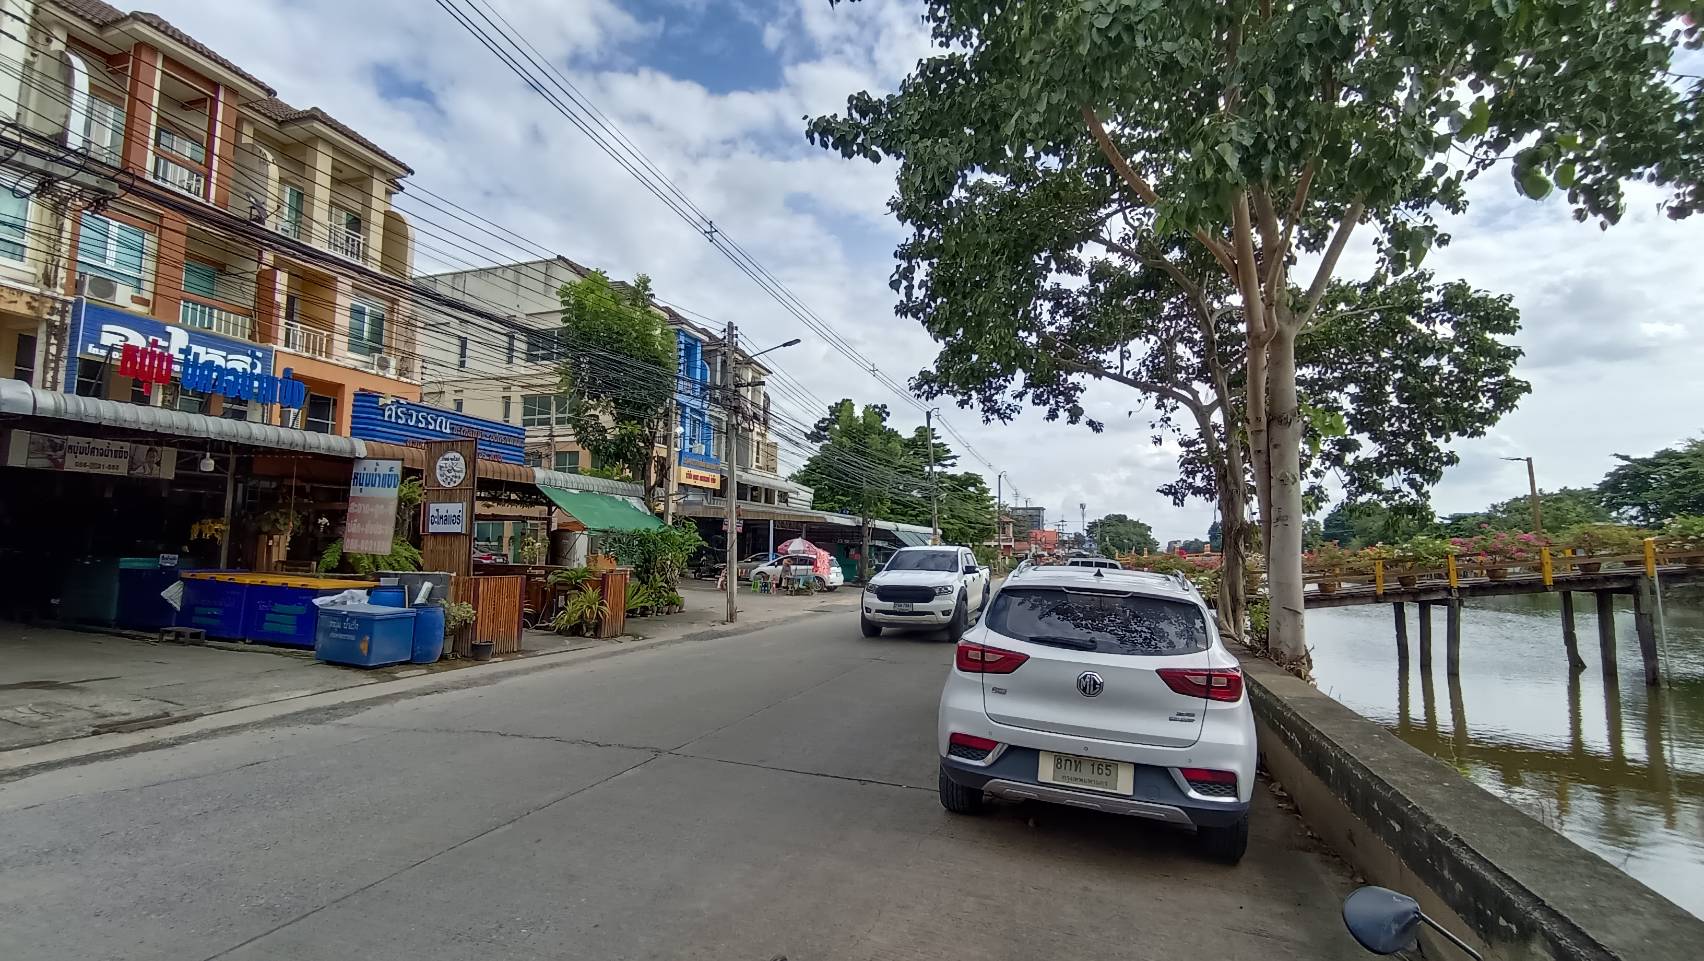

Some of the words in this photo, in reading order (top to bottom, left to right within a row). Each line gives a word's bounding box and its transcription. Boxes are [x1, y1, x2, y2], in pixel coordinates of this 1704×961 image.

[430, 508, 462, 526] อะไหล่แอร์
[1079, 673, 1102, 696] MG
[1090, 762, 1113, 777] 165
